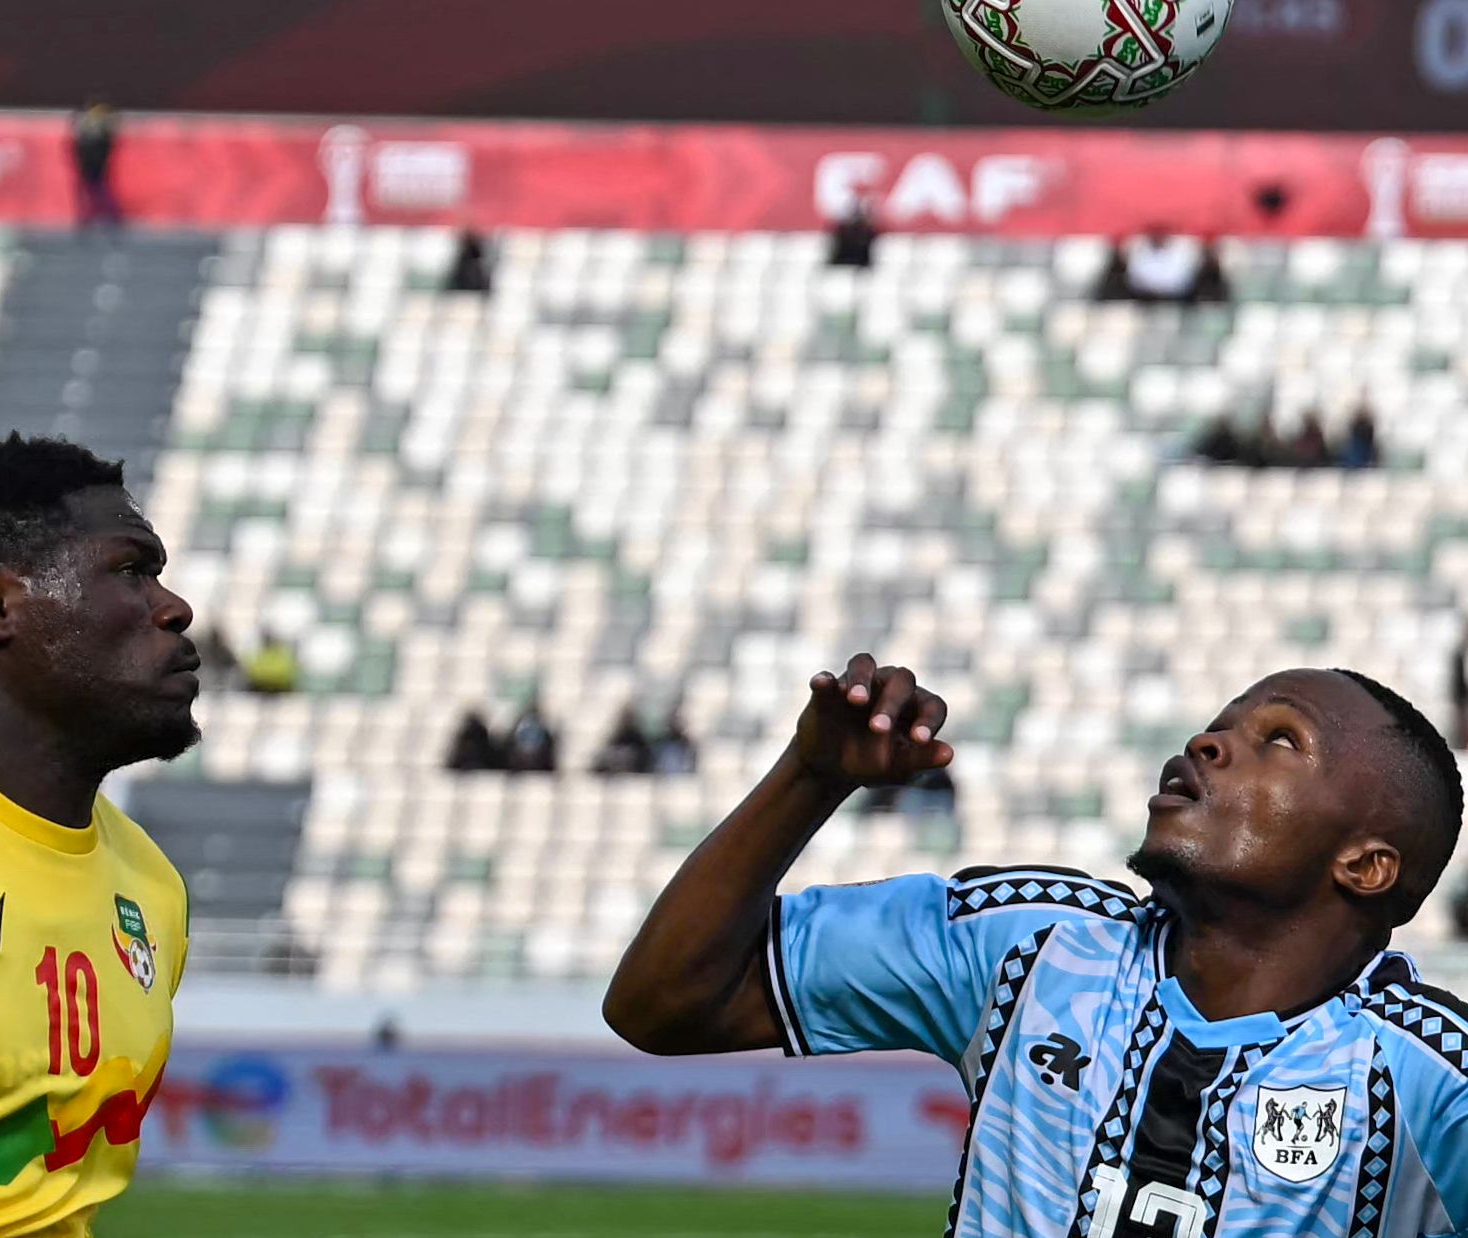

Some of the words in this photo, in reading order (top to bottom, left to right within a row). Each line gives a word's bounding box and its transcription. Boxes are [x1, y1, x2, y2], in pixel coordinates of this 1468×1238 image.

[814, 151, 1042, 224] CAF
[34, 945, 100, 1077] 10
[313, 1065, 866, 1172] TotalEnergies
[1275, 1149, 1318, 1165] BFA
